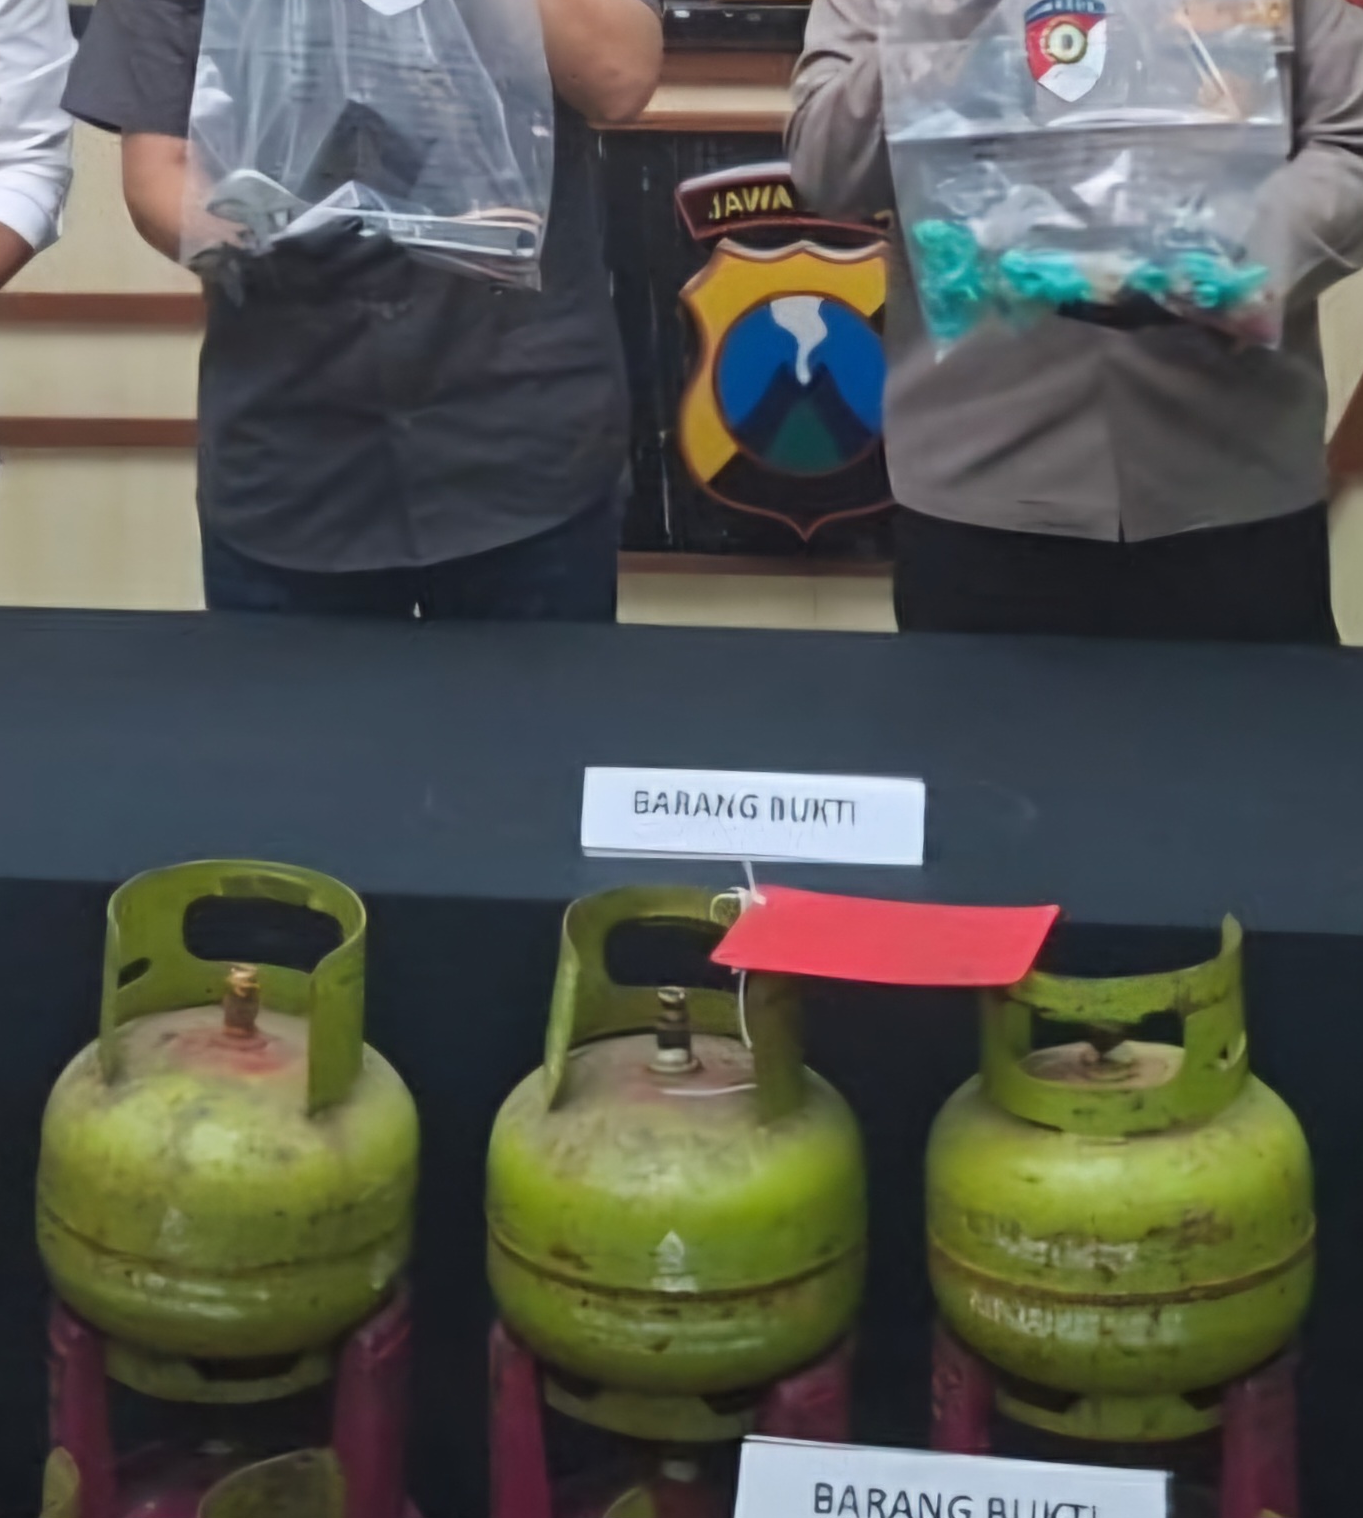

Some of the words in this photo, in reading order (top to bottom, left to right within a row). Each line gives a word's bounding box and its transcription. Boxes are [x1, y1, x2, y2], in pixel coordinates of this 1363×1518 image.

[708, 184, 794, 220] JAWA
[632, 790, 759, 822] BARANG
[770, 795, 857, 827] BUKTI
[813, 1482, 975, 1518] BARANG
